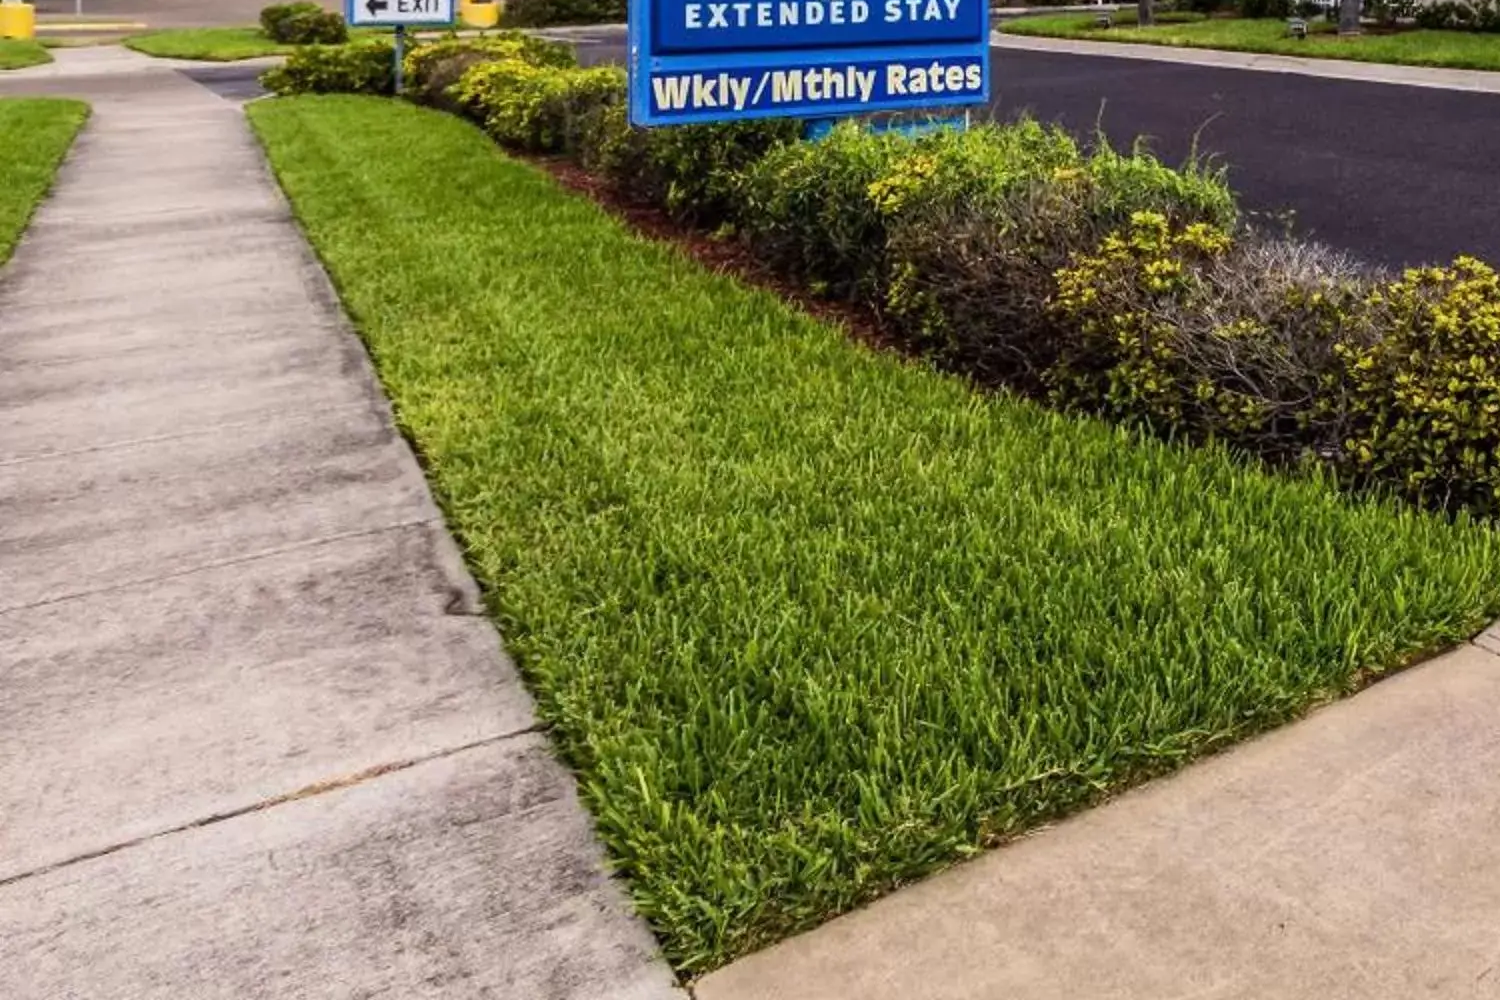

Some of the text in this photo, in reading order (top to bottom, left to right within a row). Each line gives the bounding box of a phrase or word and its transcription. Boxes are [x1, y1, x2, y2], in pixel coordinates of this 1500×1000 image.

[685, 0, 869, 29] EXTENDED
[652, 61, 982, 110] Wkly/Mthly Rates
